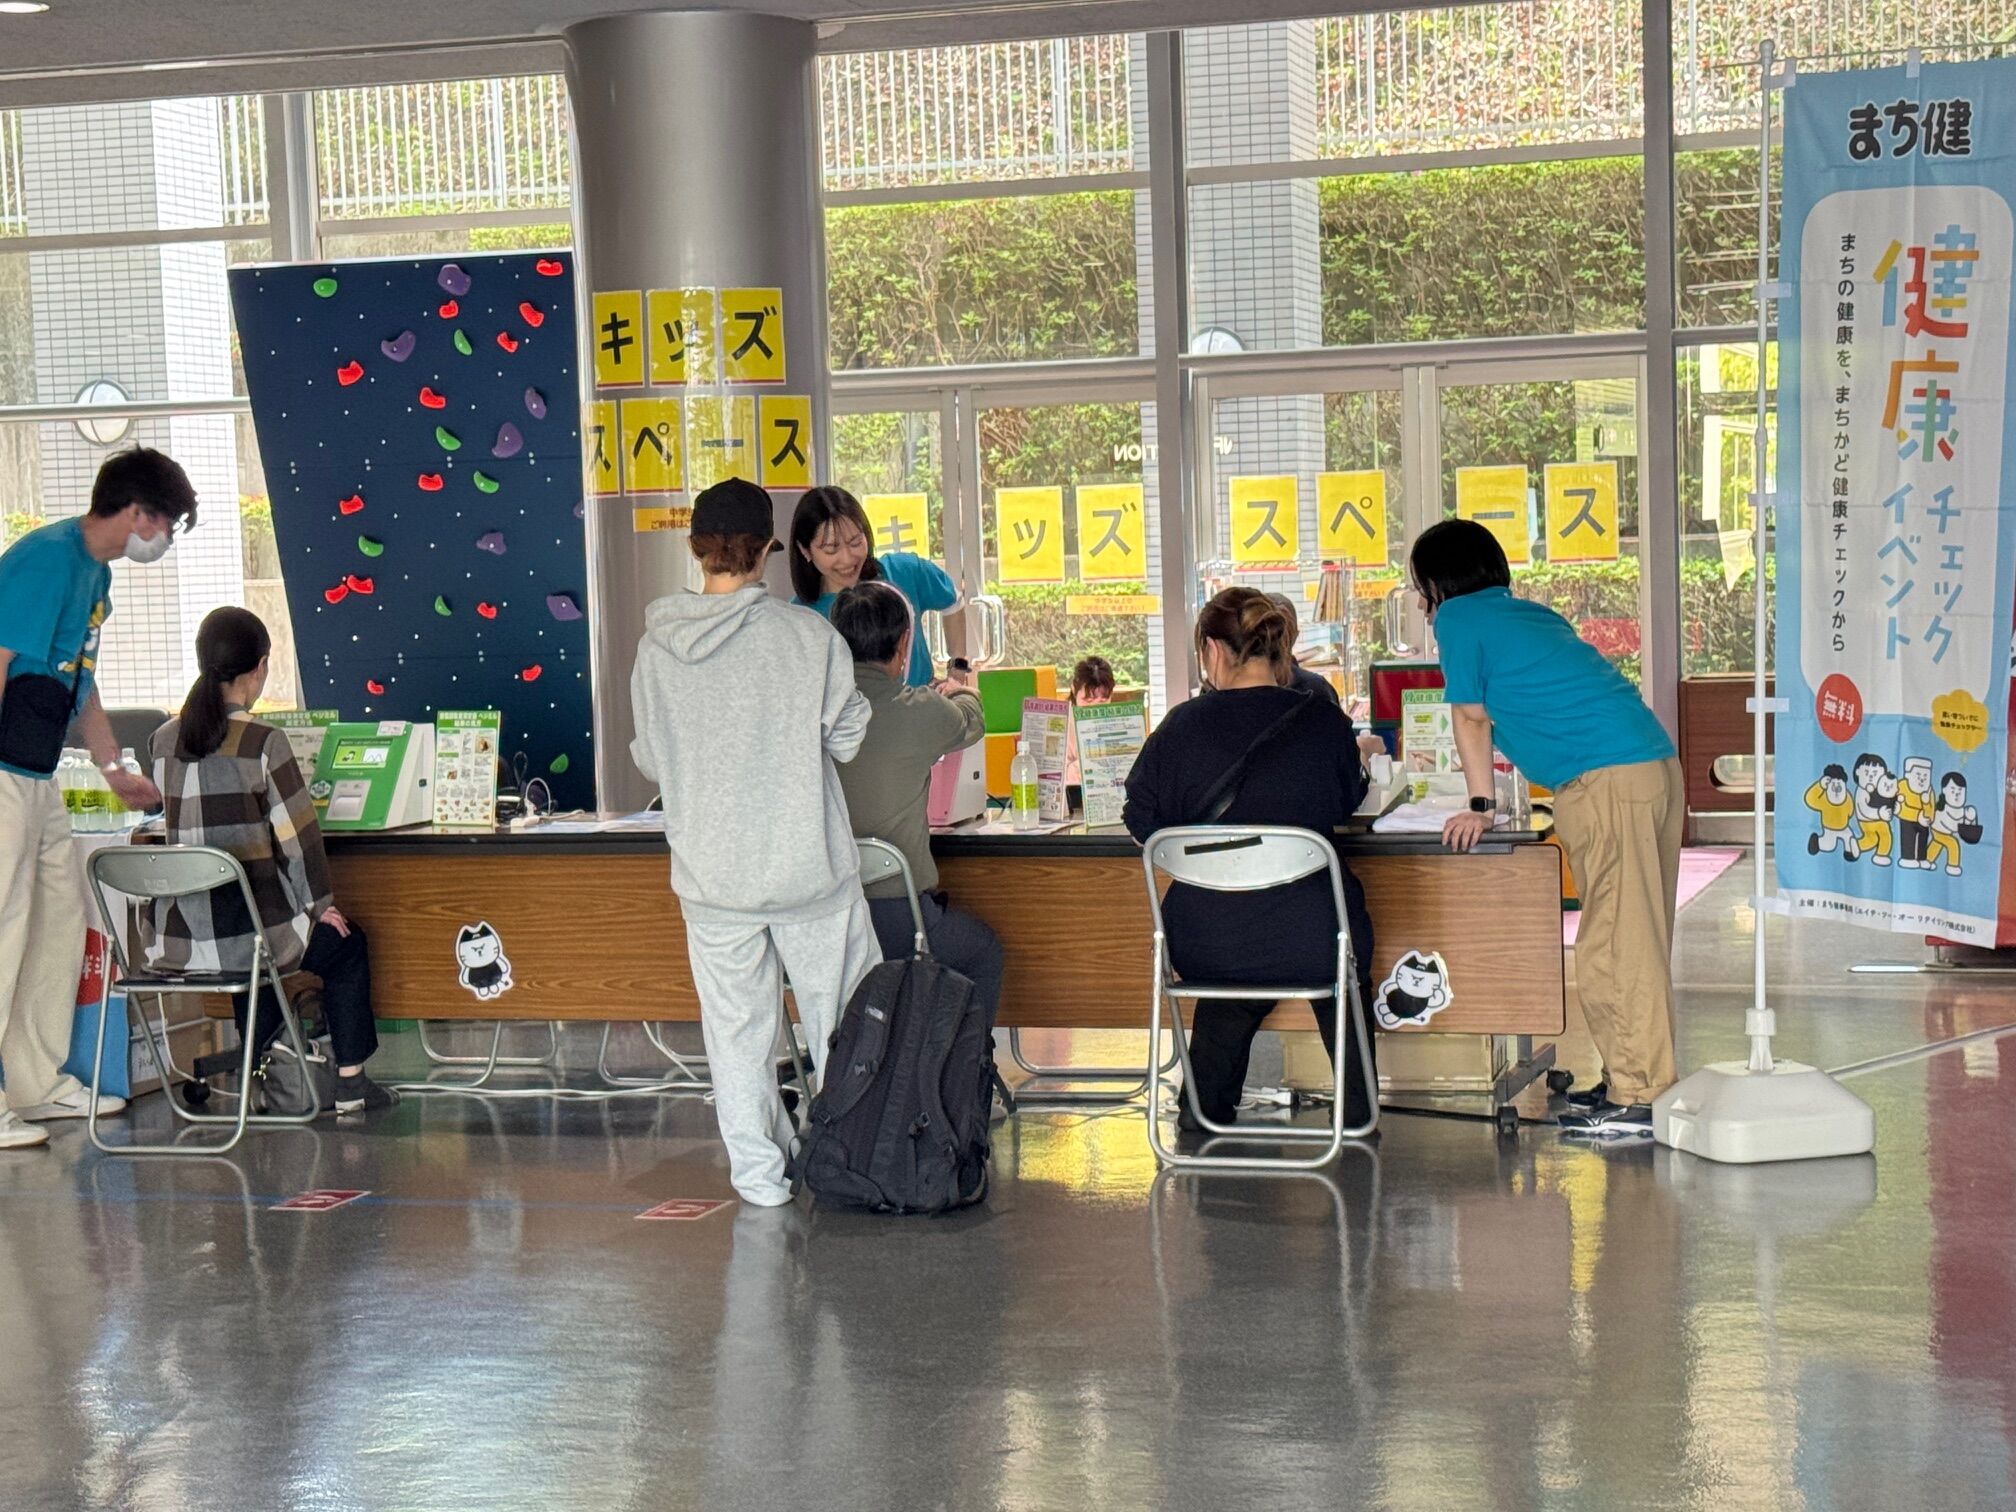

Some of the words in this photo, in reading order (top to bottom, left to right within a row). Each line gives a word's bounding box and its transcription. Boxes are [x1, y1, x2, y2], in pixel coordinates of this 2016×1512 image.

[1849, 99, 1972, 158] まち健
[601, 305, 778, 365] キッズ
[1873, 224, 1979, 463] 健康
[589, 419, 806, 472] スペース
[1242, 488, 1606, 549] スペース
[1877, 482, 1921, 660] イベント
[1923, 484, 1964, 664] チェック
[1822, 690, 1855, 726] 無料
